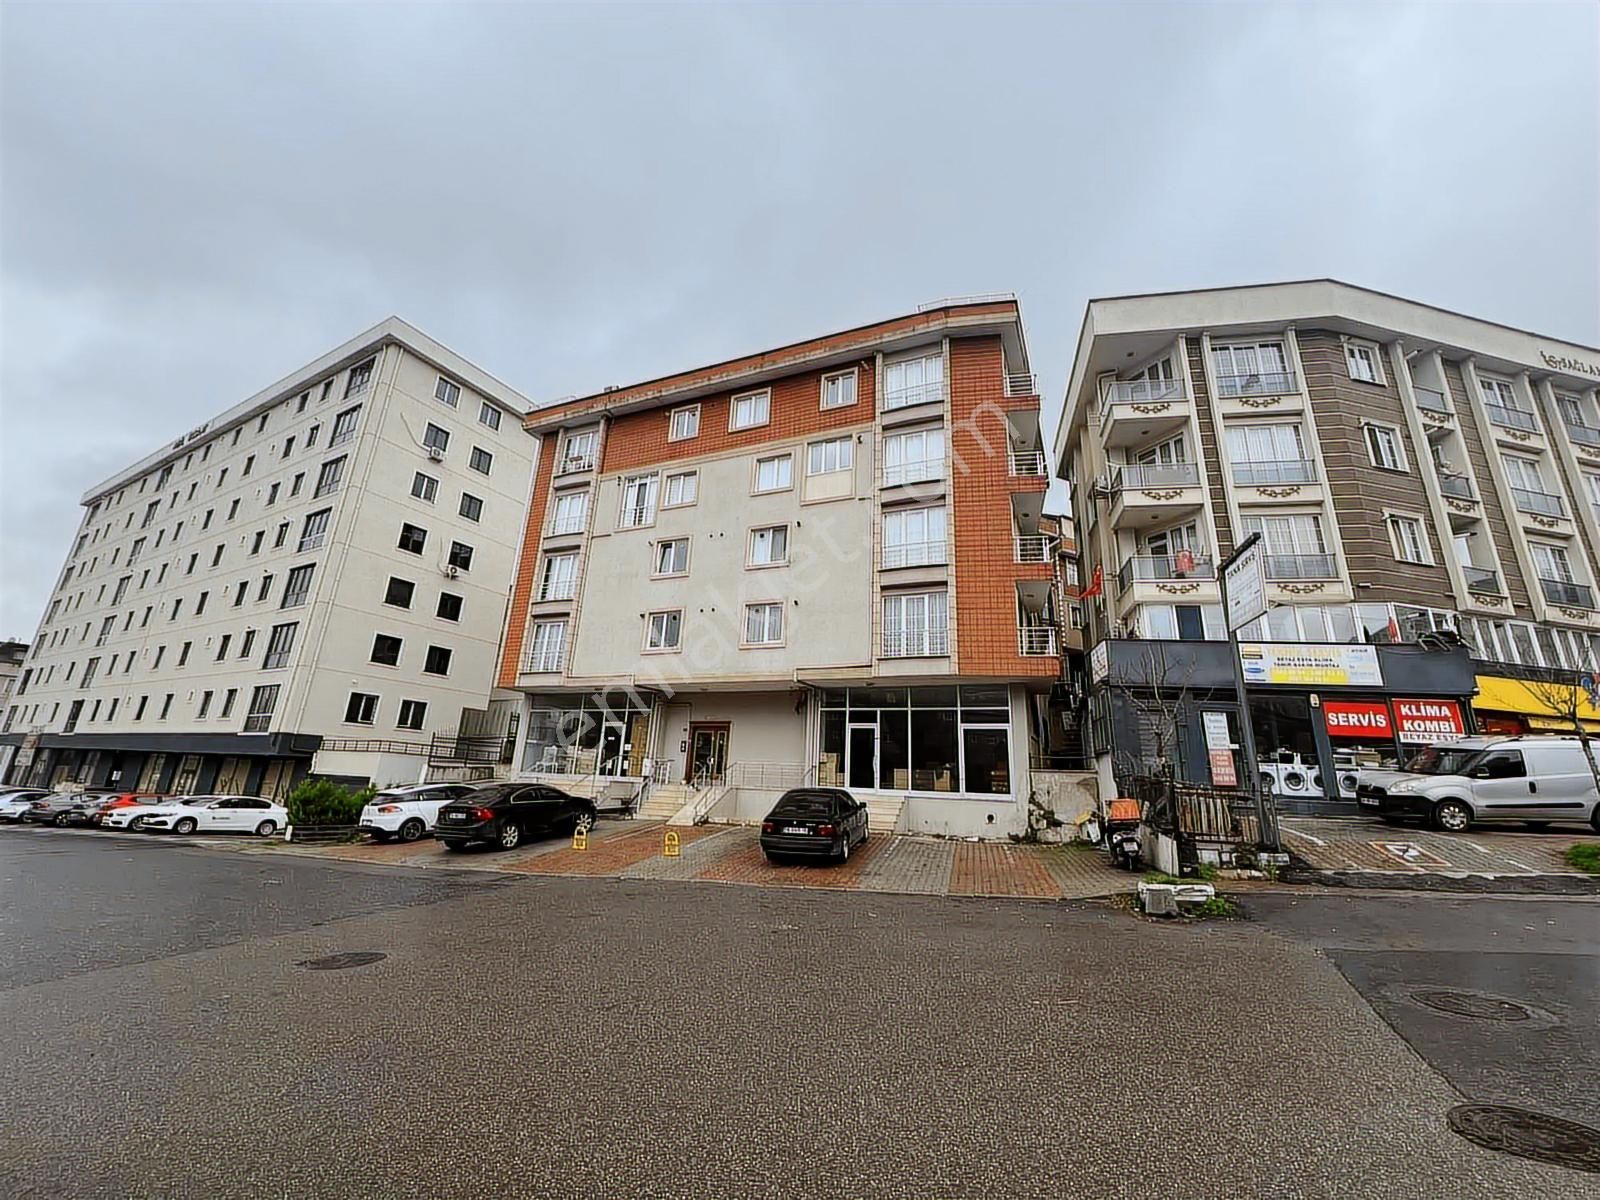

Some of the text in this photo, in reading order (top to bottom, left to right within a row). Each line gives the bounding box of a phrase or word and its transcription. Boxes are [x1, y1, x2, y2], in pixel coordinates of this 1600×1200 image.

[1400, 702, 1452, 717] KLİMA
[1328, 711, 1387, 728] SERVİS
[1403, 717, 1456, 733] KOMBİ
